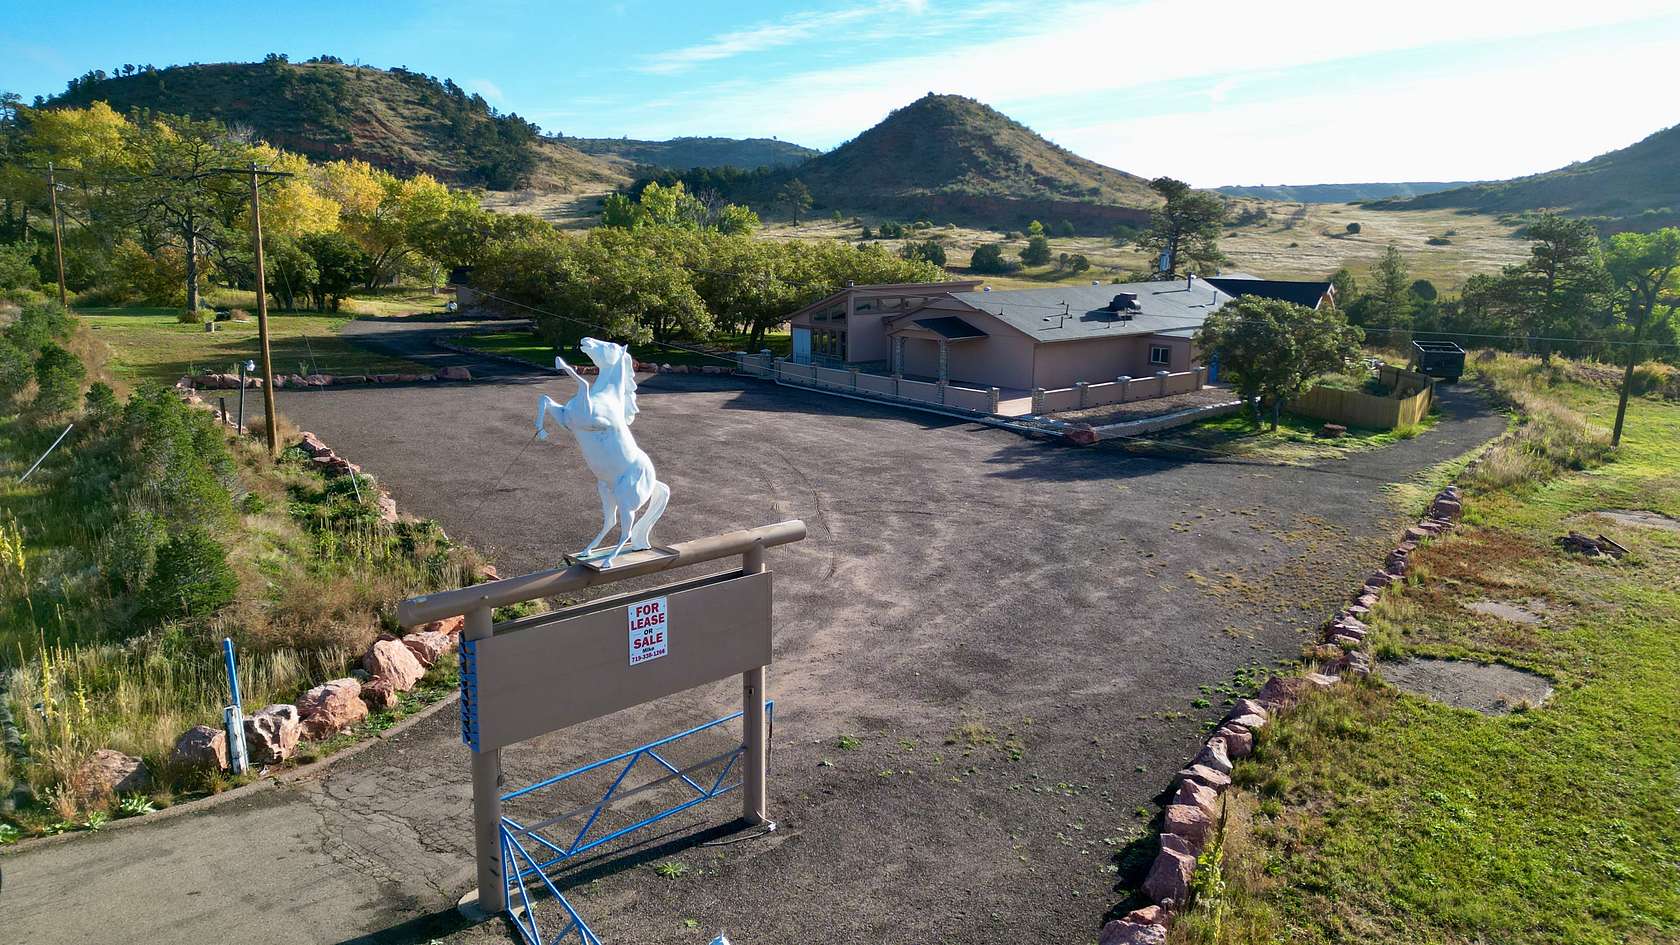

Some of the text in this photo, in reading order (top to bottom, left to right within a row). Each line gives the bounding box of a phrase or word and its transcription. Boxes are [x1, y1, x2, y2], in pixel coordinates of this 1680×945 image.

[636, 602, 659, 617] FOR
[631, 613, 664, 631] LEASE
[633, 633, 663, 649] SALE
